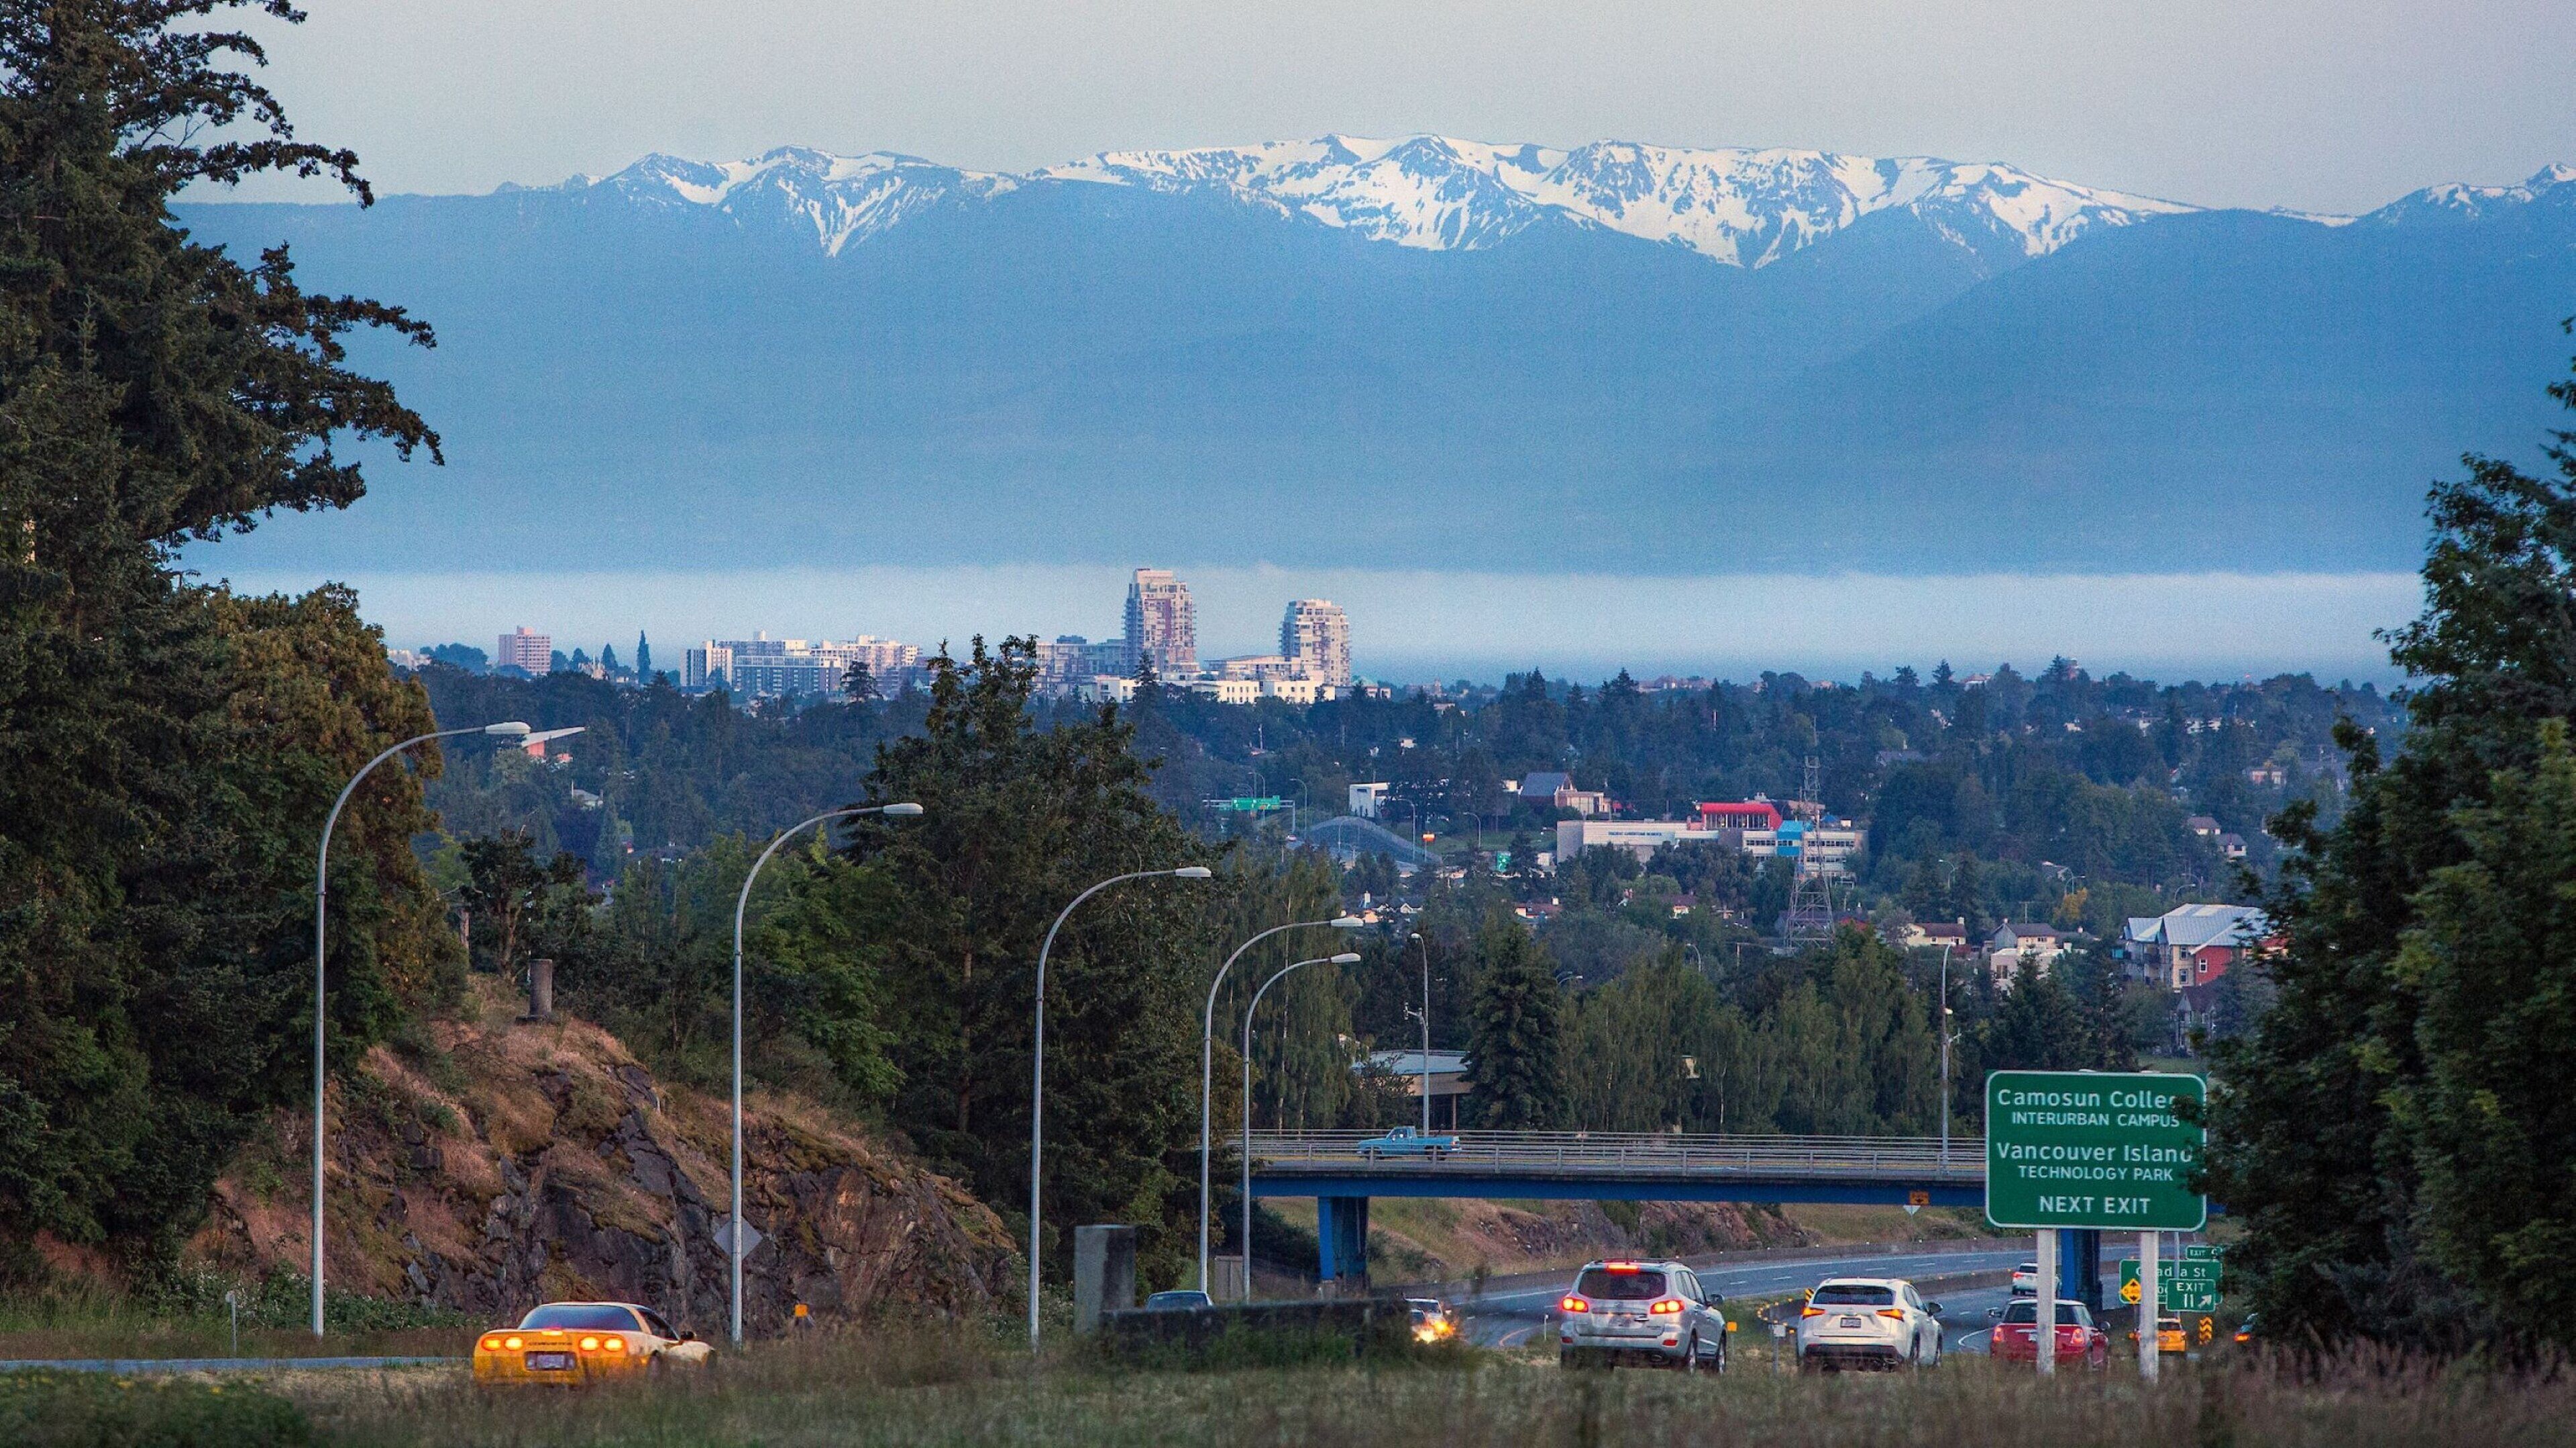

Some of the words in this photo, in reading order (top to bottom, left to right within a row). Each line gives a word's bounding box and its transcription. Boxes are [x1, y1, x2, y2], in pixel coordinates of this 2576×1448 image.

[1998, 1089, 2100, 1107] Camosun
[2012, 1111, 2109, 1125] INTERURBAN
[2117, 1113, 2180, 1127] CAMPUS
[1996, 1142, 2116, 1161] Vancouver
[2019, 1165, 2127, 1180] TECHNOLOGY
[2133, 1168, 2174, 1181] PARK
[2039, 1196, 2095, 1213] NEXT
[2104, 1197, 2151, 1214] EXIT
[2194, 1268, 2206, 1278] St
[2176, 1282, 2205, 1292] EXIT
[2184, 1294, 2194, 1307] 11
